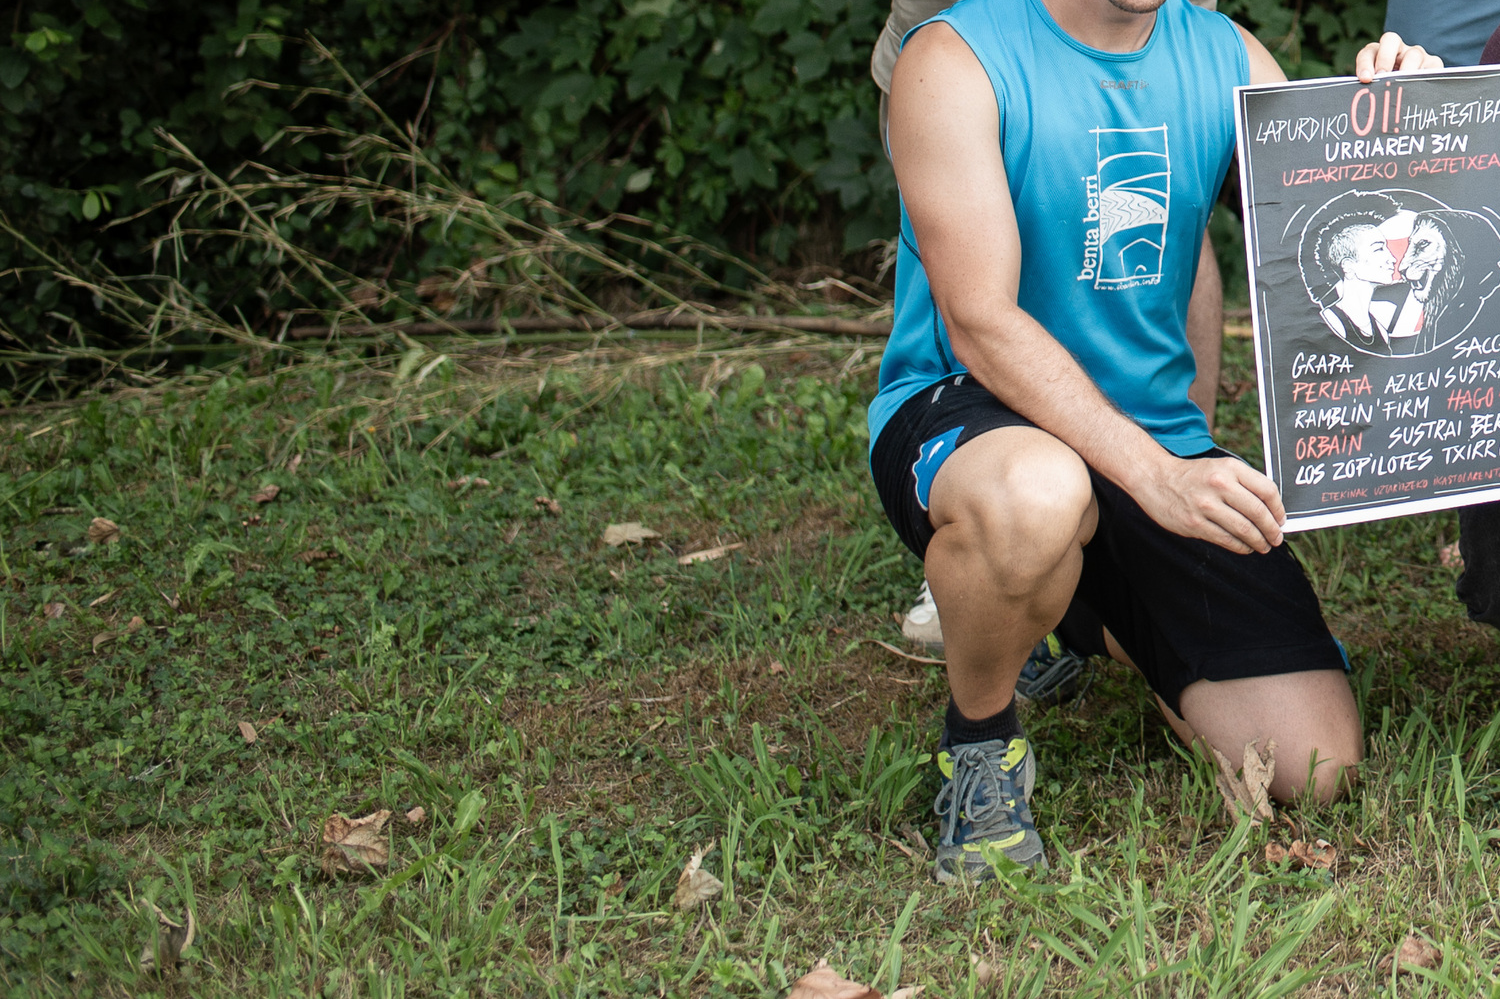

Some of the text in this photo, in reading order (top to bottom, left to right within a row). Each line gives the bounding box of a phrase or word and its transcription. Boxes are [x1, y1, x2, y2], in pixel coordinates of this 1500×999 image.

[1256, 113, 1348, 144] LAPURDIKO
[1325, 133, 1469, 162] URRIAREN 31N
[1283, 162, 1398, 186] UZTARITZEKO
[1077, 174, 1100, 282] benta berri
[1292, 352, 1353, 379] GRAPA
[1292, 374, 1373, 403] PERLATA
[1384, 368, 1441, 394] AZKEN
[1447, 388, 1494, 411] HAGO
[1295, 464, 1325, 485] LOS
